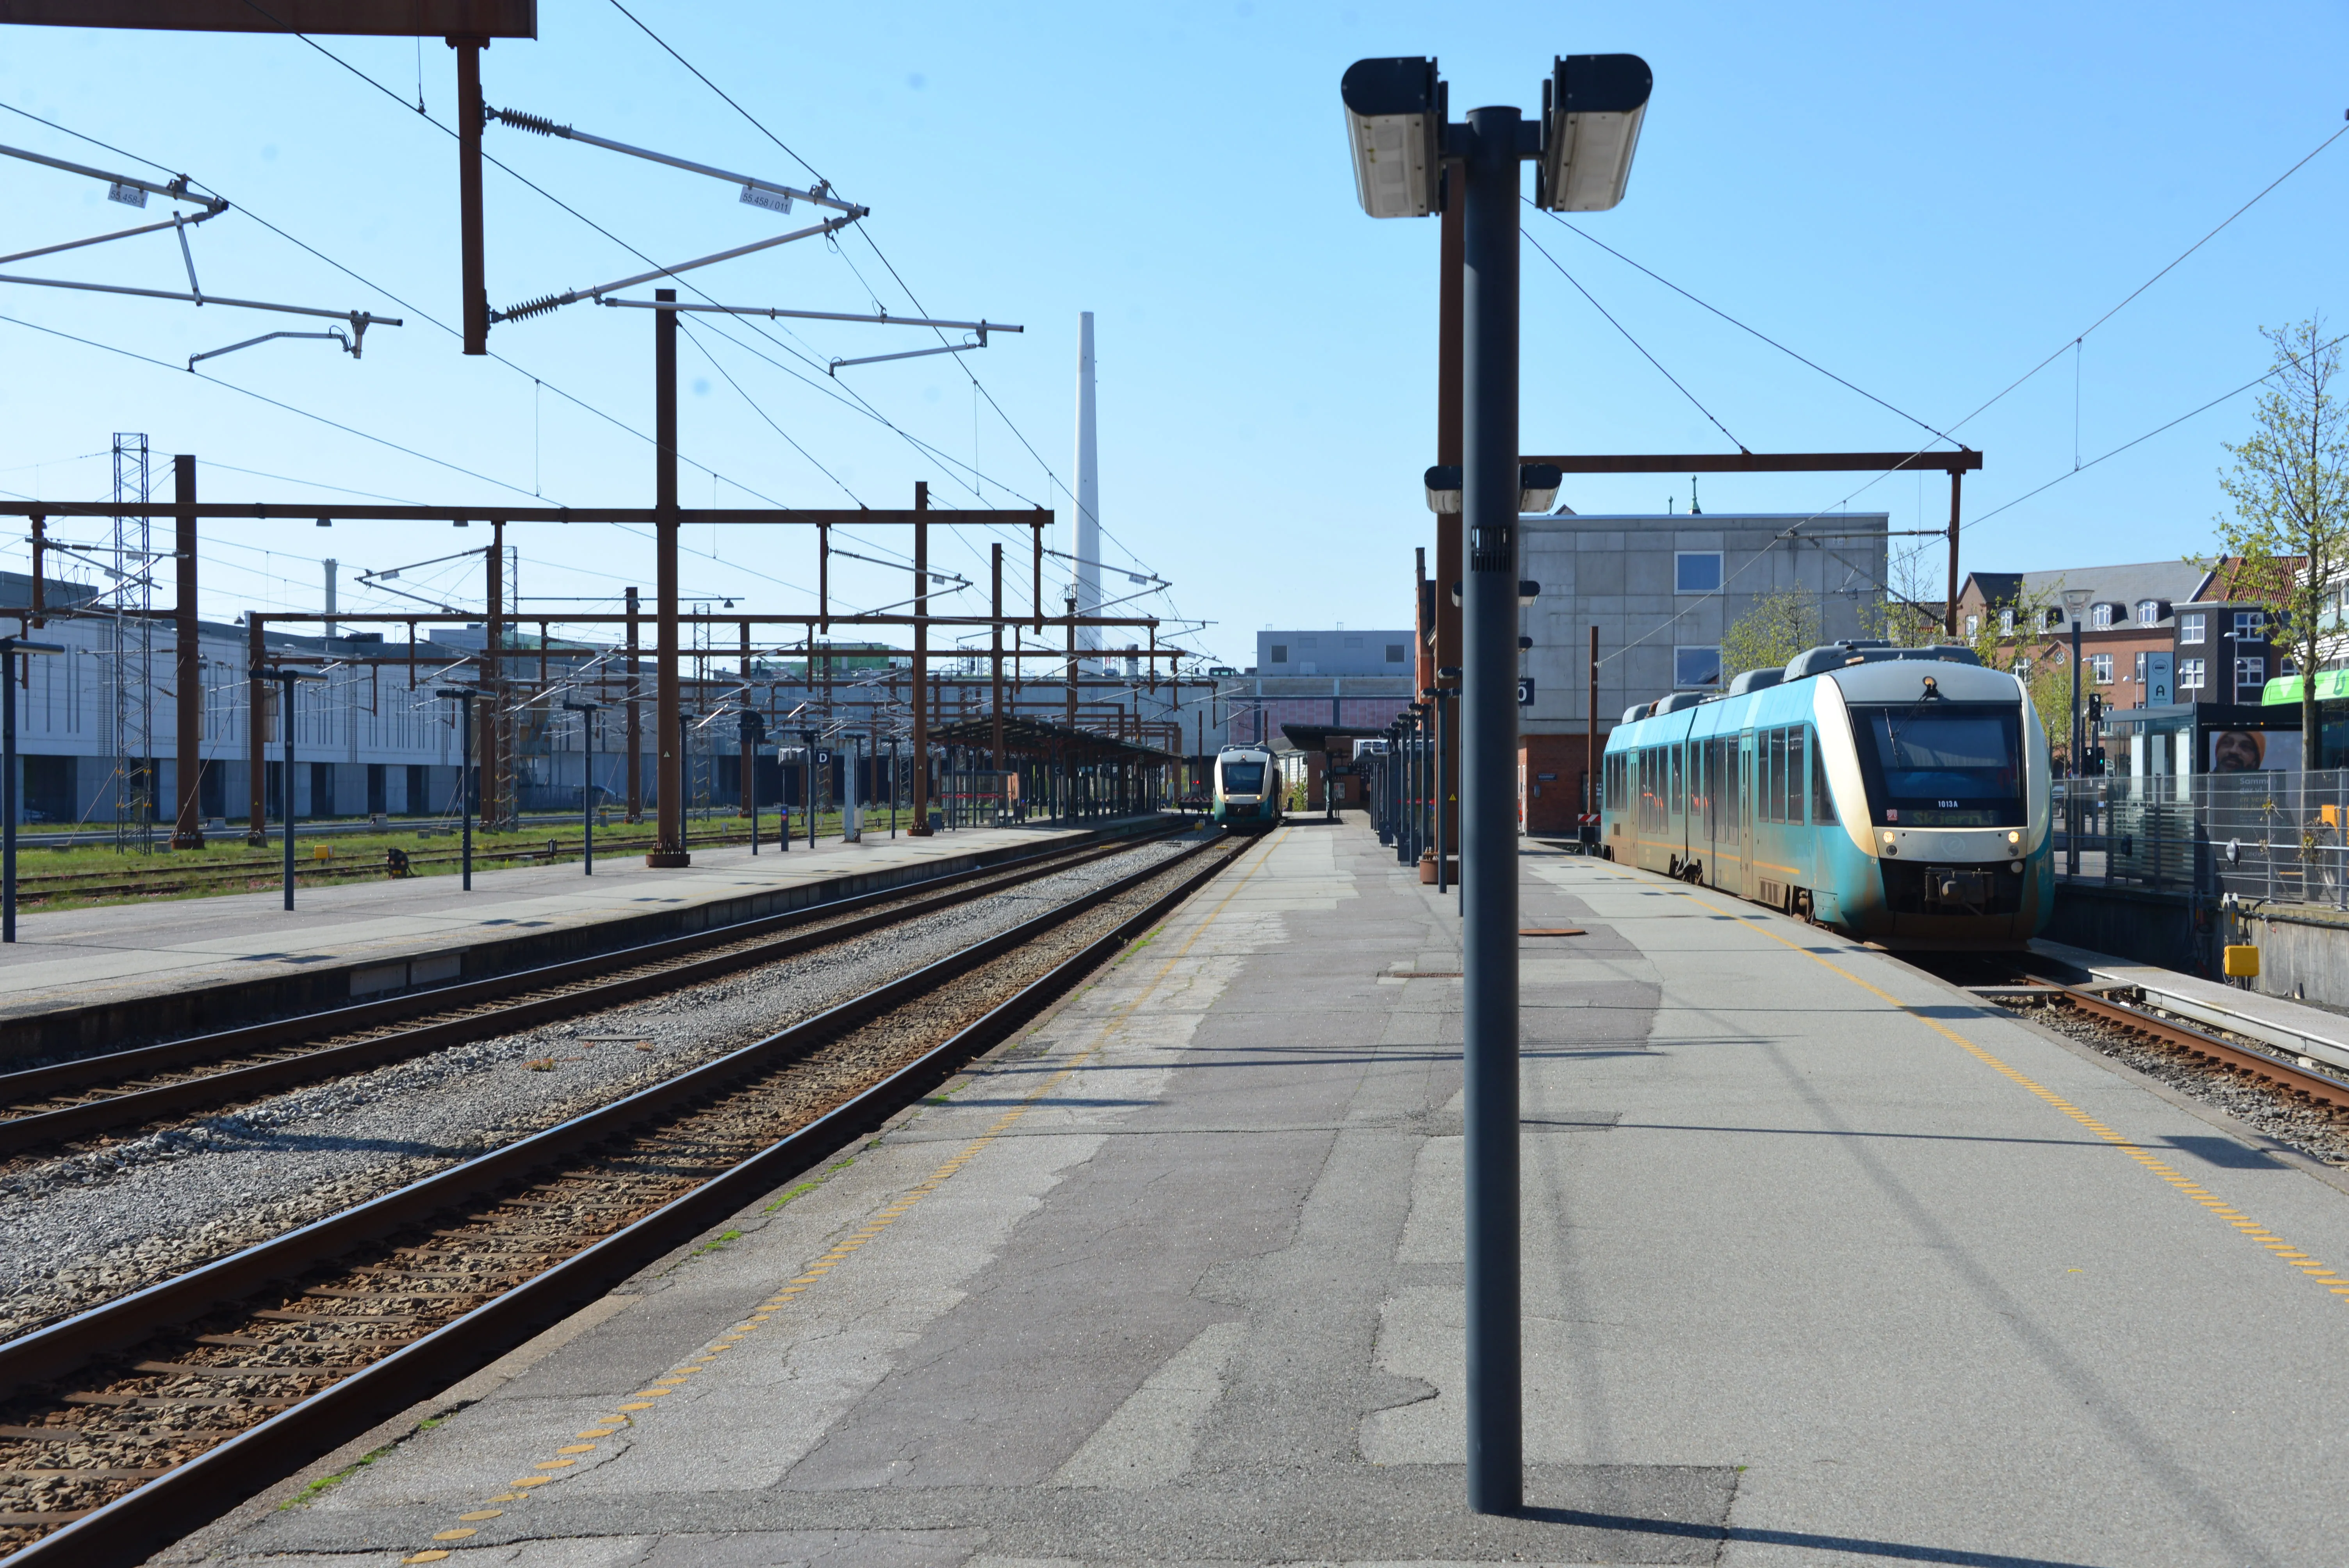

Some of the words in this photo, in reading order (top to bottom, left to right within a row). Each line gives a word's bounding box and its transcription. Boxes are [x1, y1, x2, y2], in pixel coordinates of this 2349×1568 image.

[743, 193, 769, 207] 55.458
[775, 201, 788, 212] 011
[819, 753, 827, 763] D
[1913, 812, 1982, 825] Skjern
